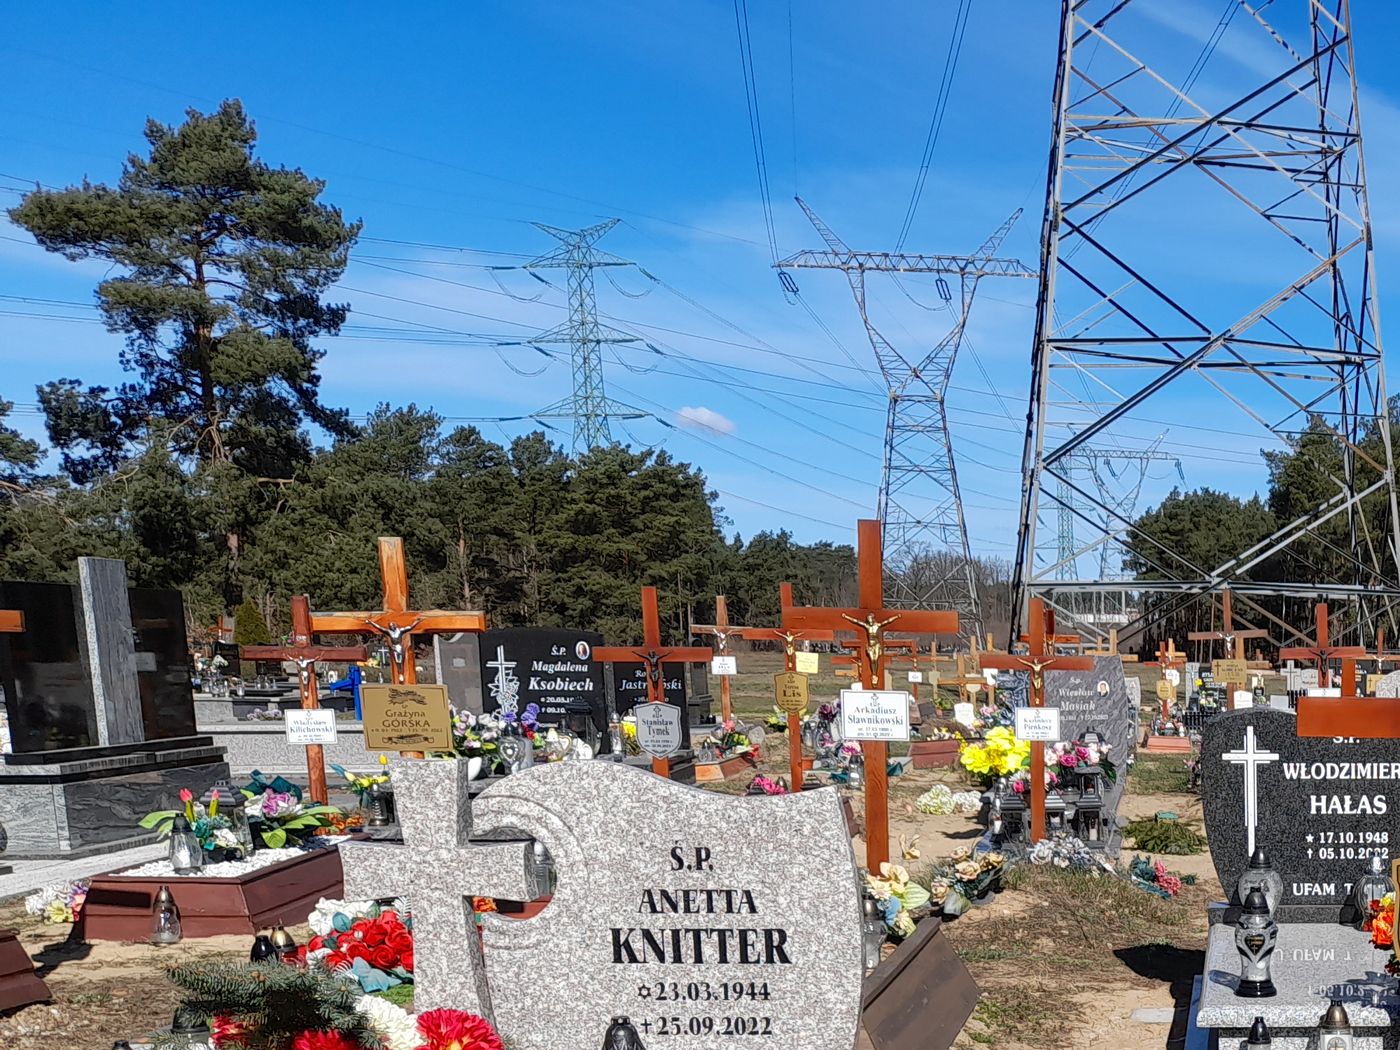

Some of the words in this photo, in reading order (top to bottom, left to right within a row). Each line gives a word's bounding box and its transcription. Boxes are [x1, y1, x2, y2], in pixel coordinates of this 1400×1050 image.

[531, 661, 588, 673] Magdalena
[528, 677, 594, 691] Ksobiech
[783, 689, 802, 698] Lis
[385, 709, 426, 719] Grażyna
[854, 706, 897, 715] Arkadiusz
[382, 718, 430, 728] GÓRSKA
[847, 714, 904, 725] Sławnikowski
[1309, 795, 1387, 815] HAŁAS
[1319, 832, 1389, 844] 17.10.1948
[670, 840, 714, 871] Ś.P.
[1292, 883, 1336, 896] UFAM
[638, 888, 759, 914] ANETTA
[609, 927, 793, 965] KNITTER
[654, 981, 771, 1001] 23.03.1944
[656, 1016, 773, 1036] 25.09.2022
